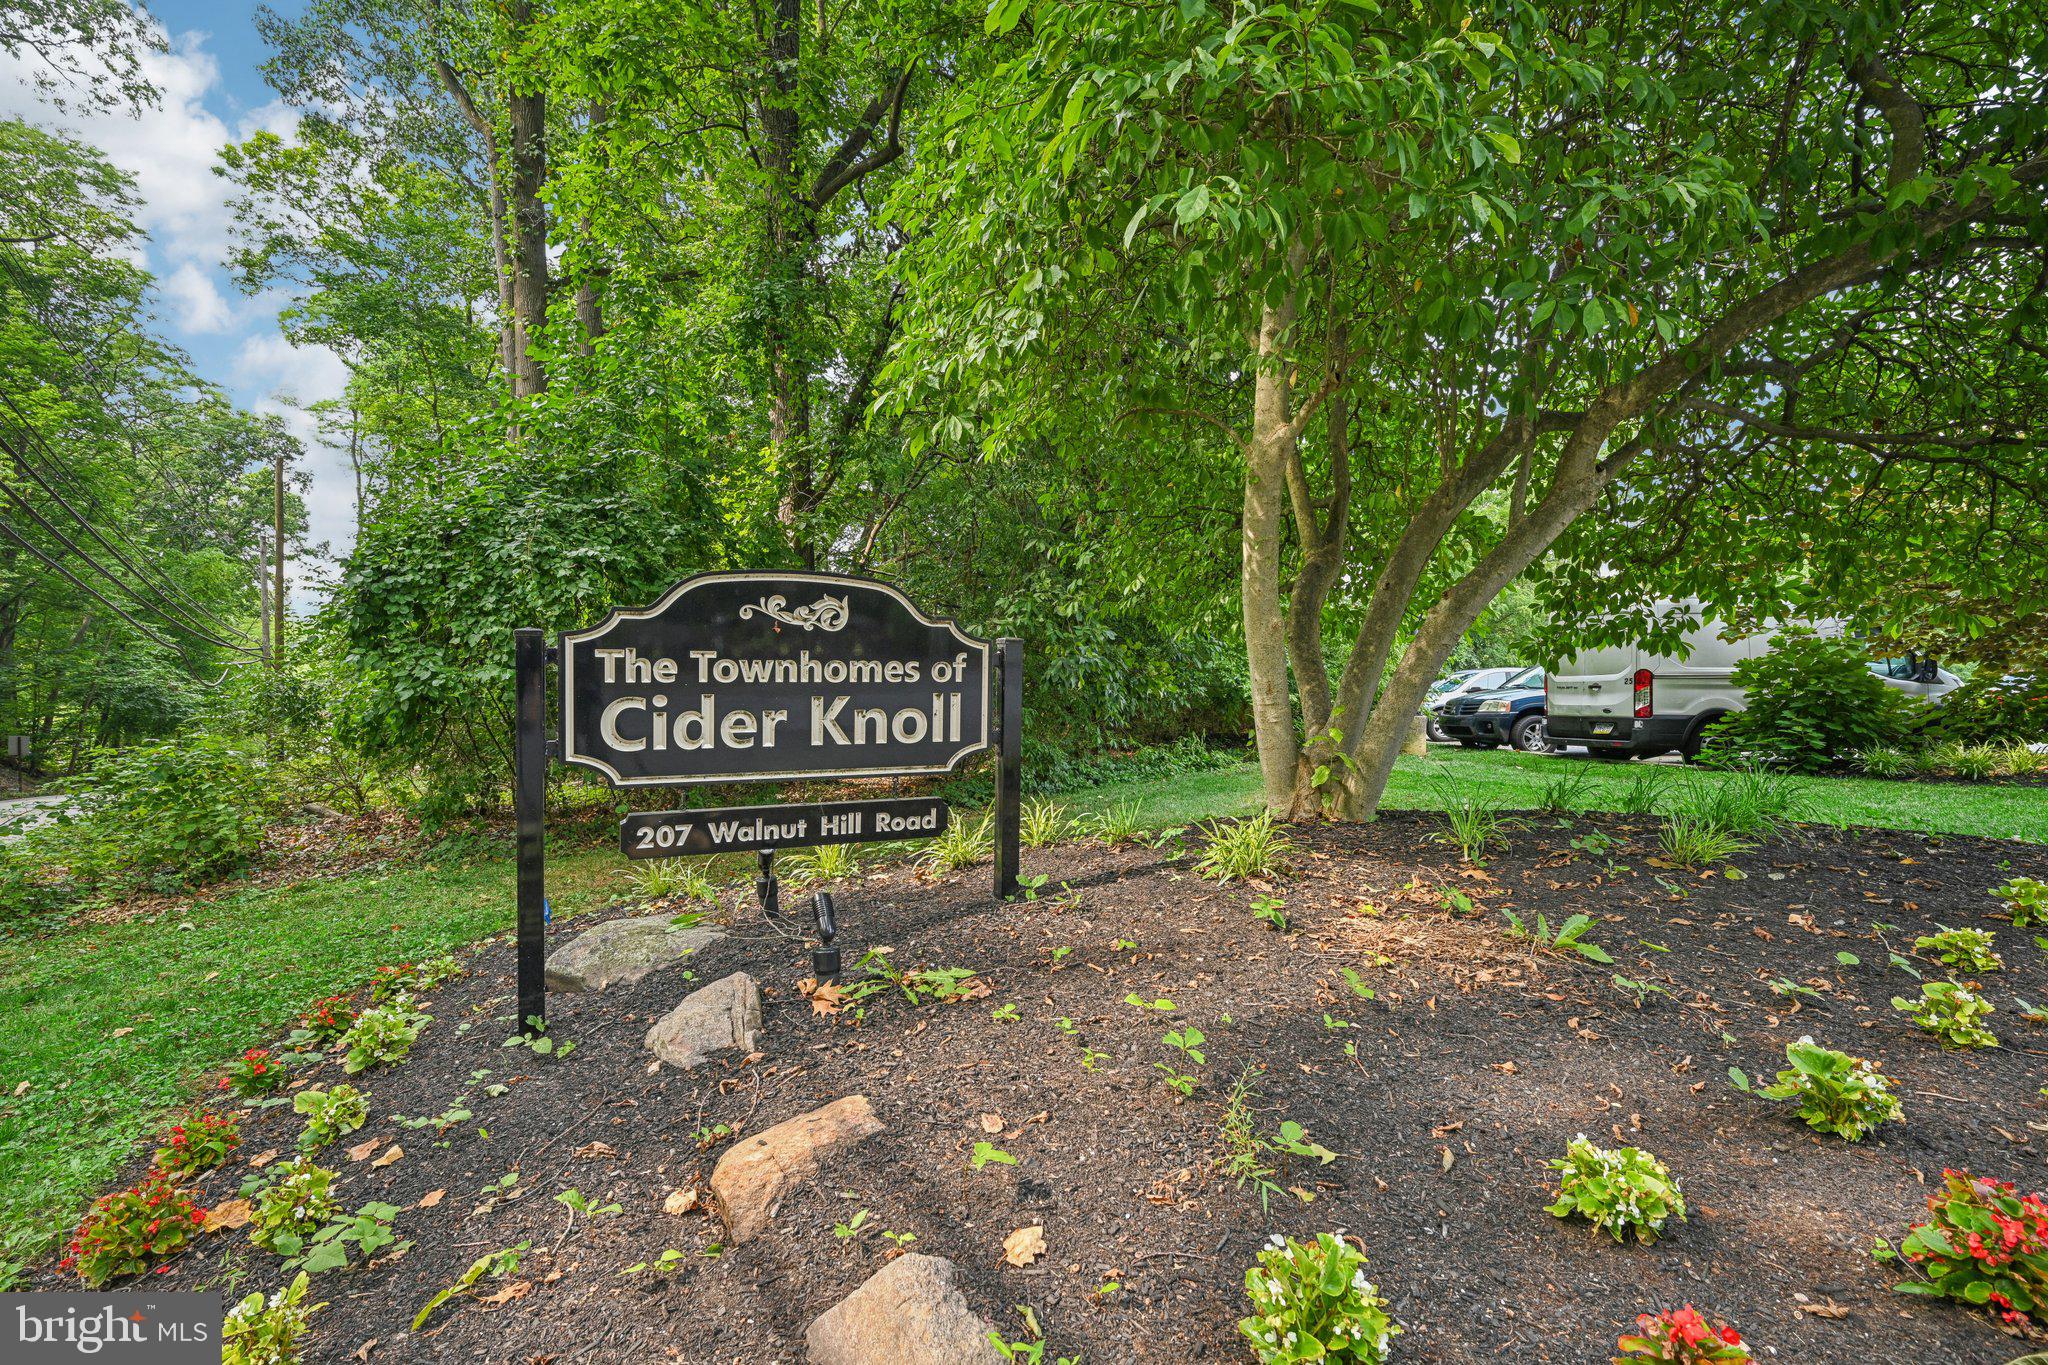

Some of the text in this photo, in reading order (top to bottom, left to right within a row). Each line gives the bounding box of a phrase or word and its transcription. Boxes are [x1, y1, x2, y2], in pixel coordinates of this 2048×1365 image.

[595, 647, 967, 684] The Townhomes of
[600, 692, 962, 752] Cider Knoll
[636, 808, 937, 850] 207 Walnut Hill Road
